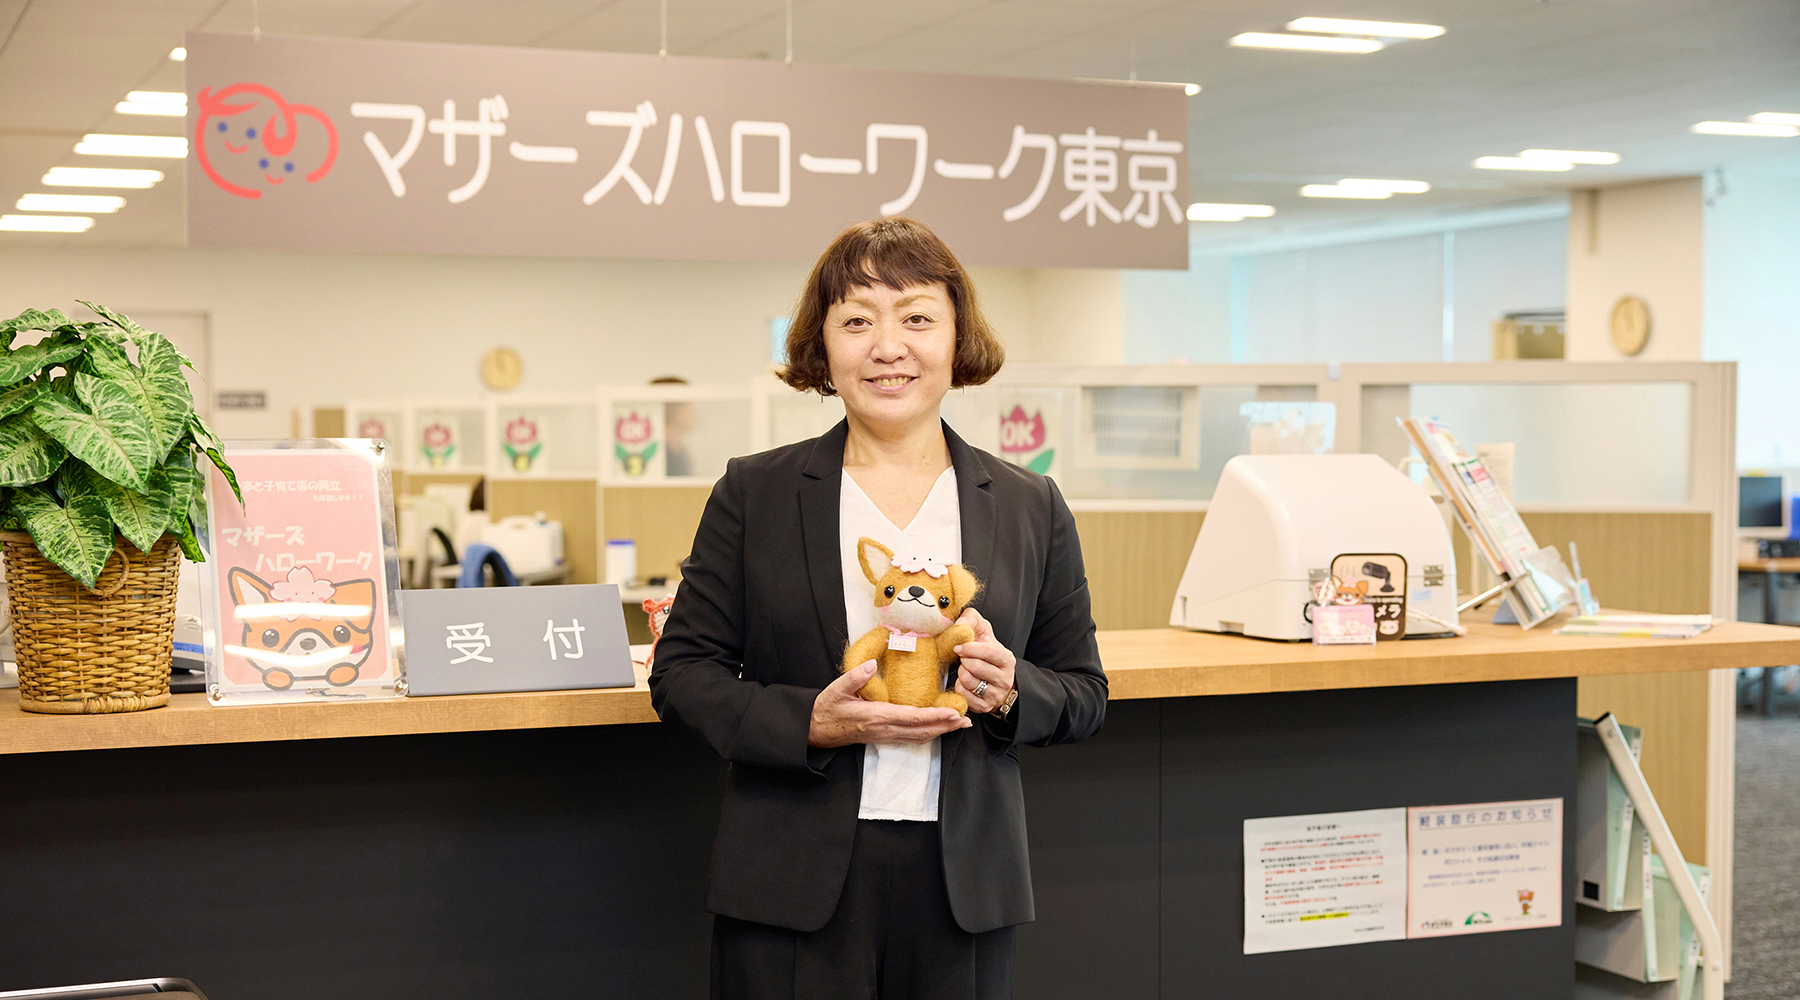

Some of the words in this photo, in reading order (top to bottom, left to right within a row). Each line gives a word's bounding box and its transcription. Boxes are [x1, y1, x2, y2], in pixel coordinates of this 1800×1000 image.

[351, 95, 1184, 228] マザーズハローワーク東京
[619, 420, 649, 441] OK
[1001, 420, 1036, 447] OK
[239, 480, 341, 492] 事と子育て等の両立
[221, 525, 305, 547] マザーズ
[255, 551, 373, 572] ハローワーク
